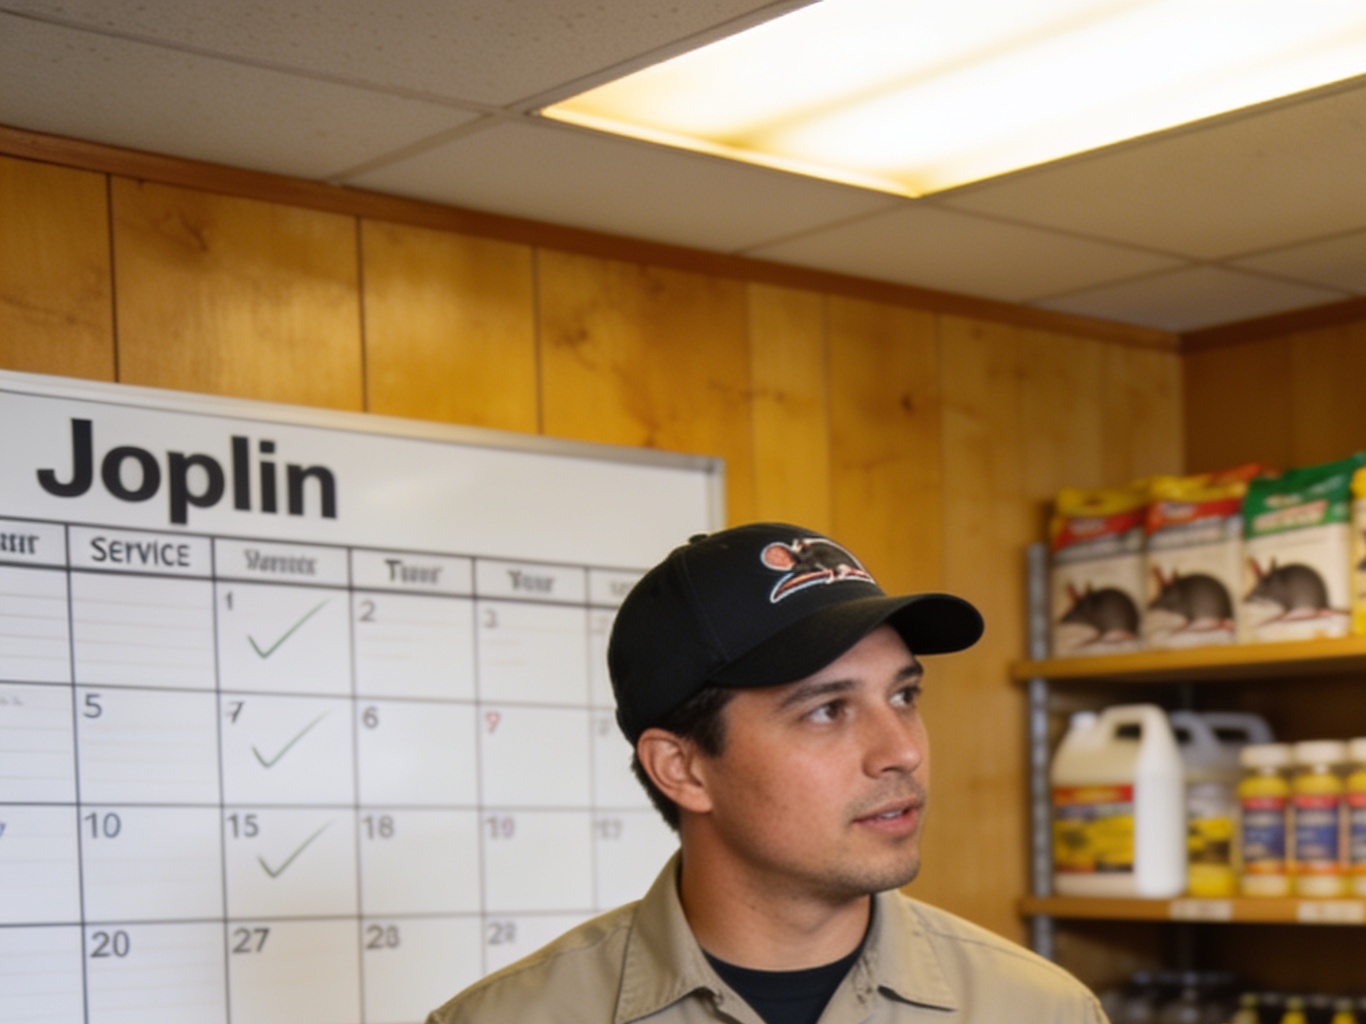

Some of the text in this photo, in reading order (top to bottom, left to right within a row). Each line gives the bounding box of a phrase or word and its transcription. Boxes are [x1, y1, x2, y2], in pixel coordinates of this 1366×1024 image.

[36, 417, 337, 525] Joplin
[358, 600, 377, 623] 2
[83, 693, 103, 719] 5
[226, 700, 245, 725] 7
[362, 705, 380, 731] 6
[85, 812, 122, 840] 10
[227, 813, 260, 840] 15
[362, 814, 395, 841] 18
[90, 930, 131, 959] 20
[232, 927, 271, 955] 27
